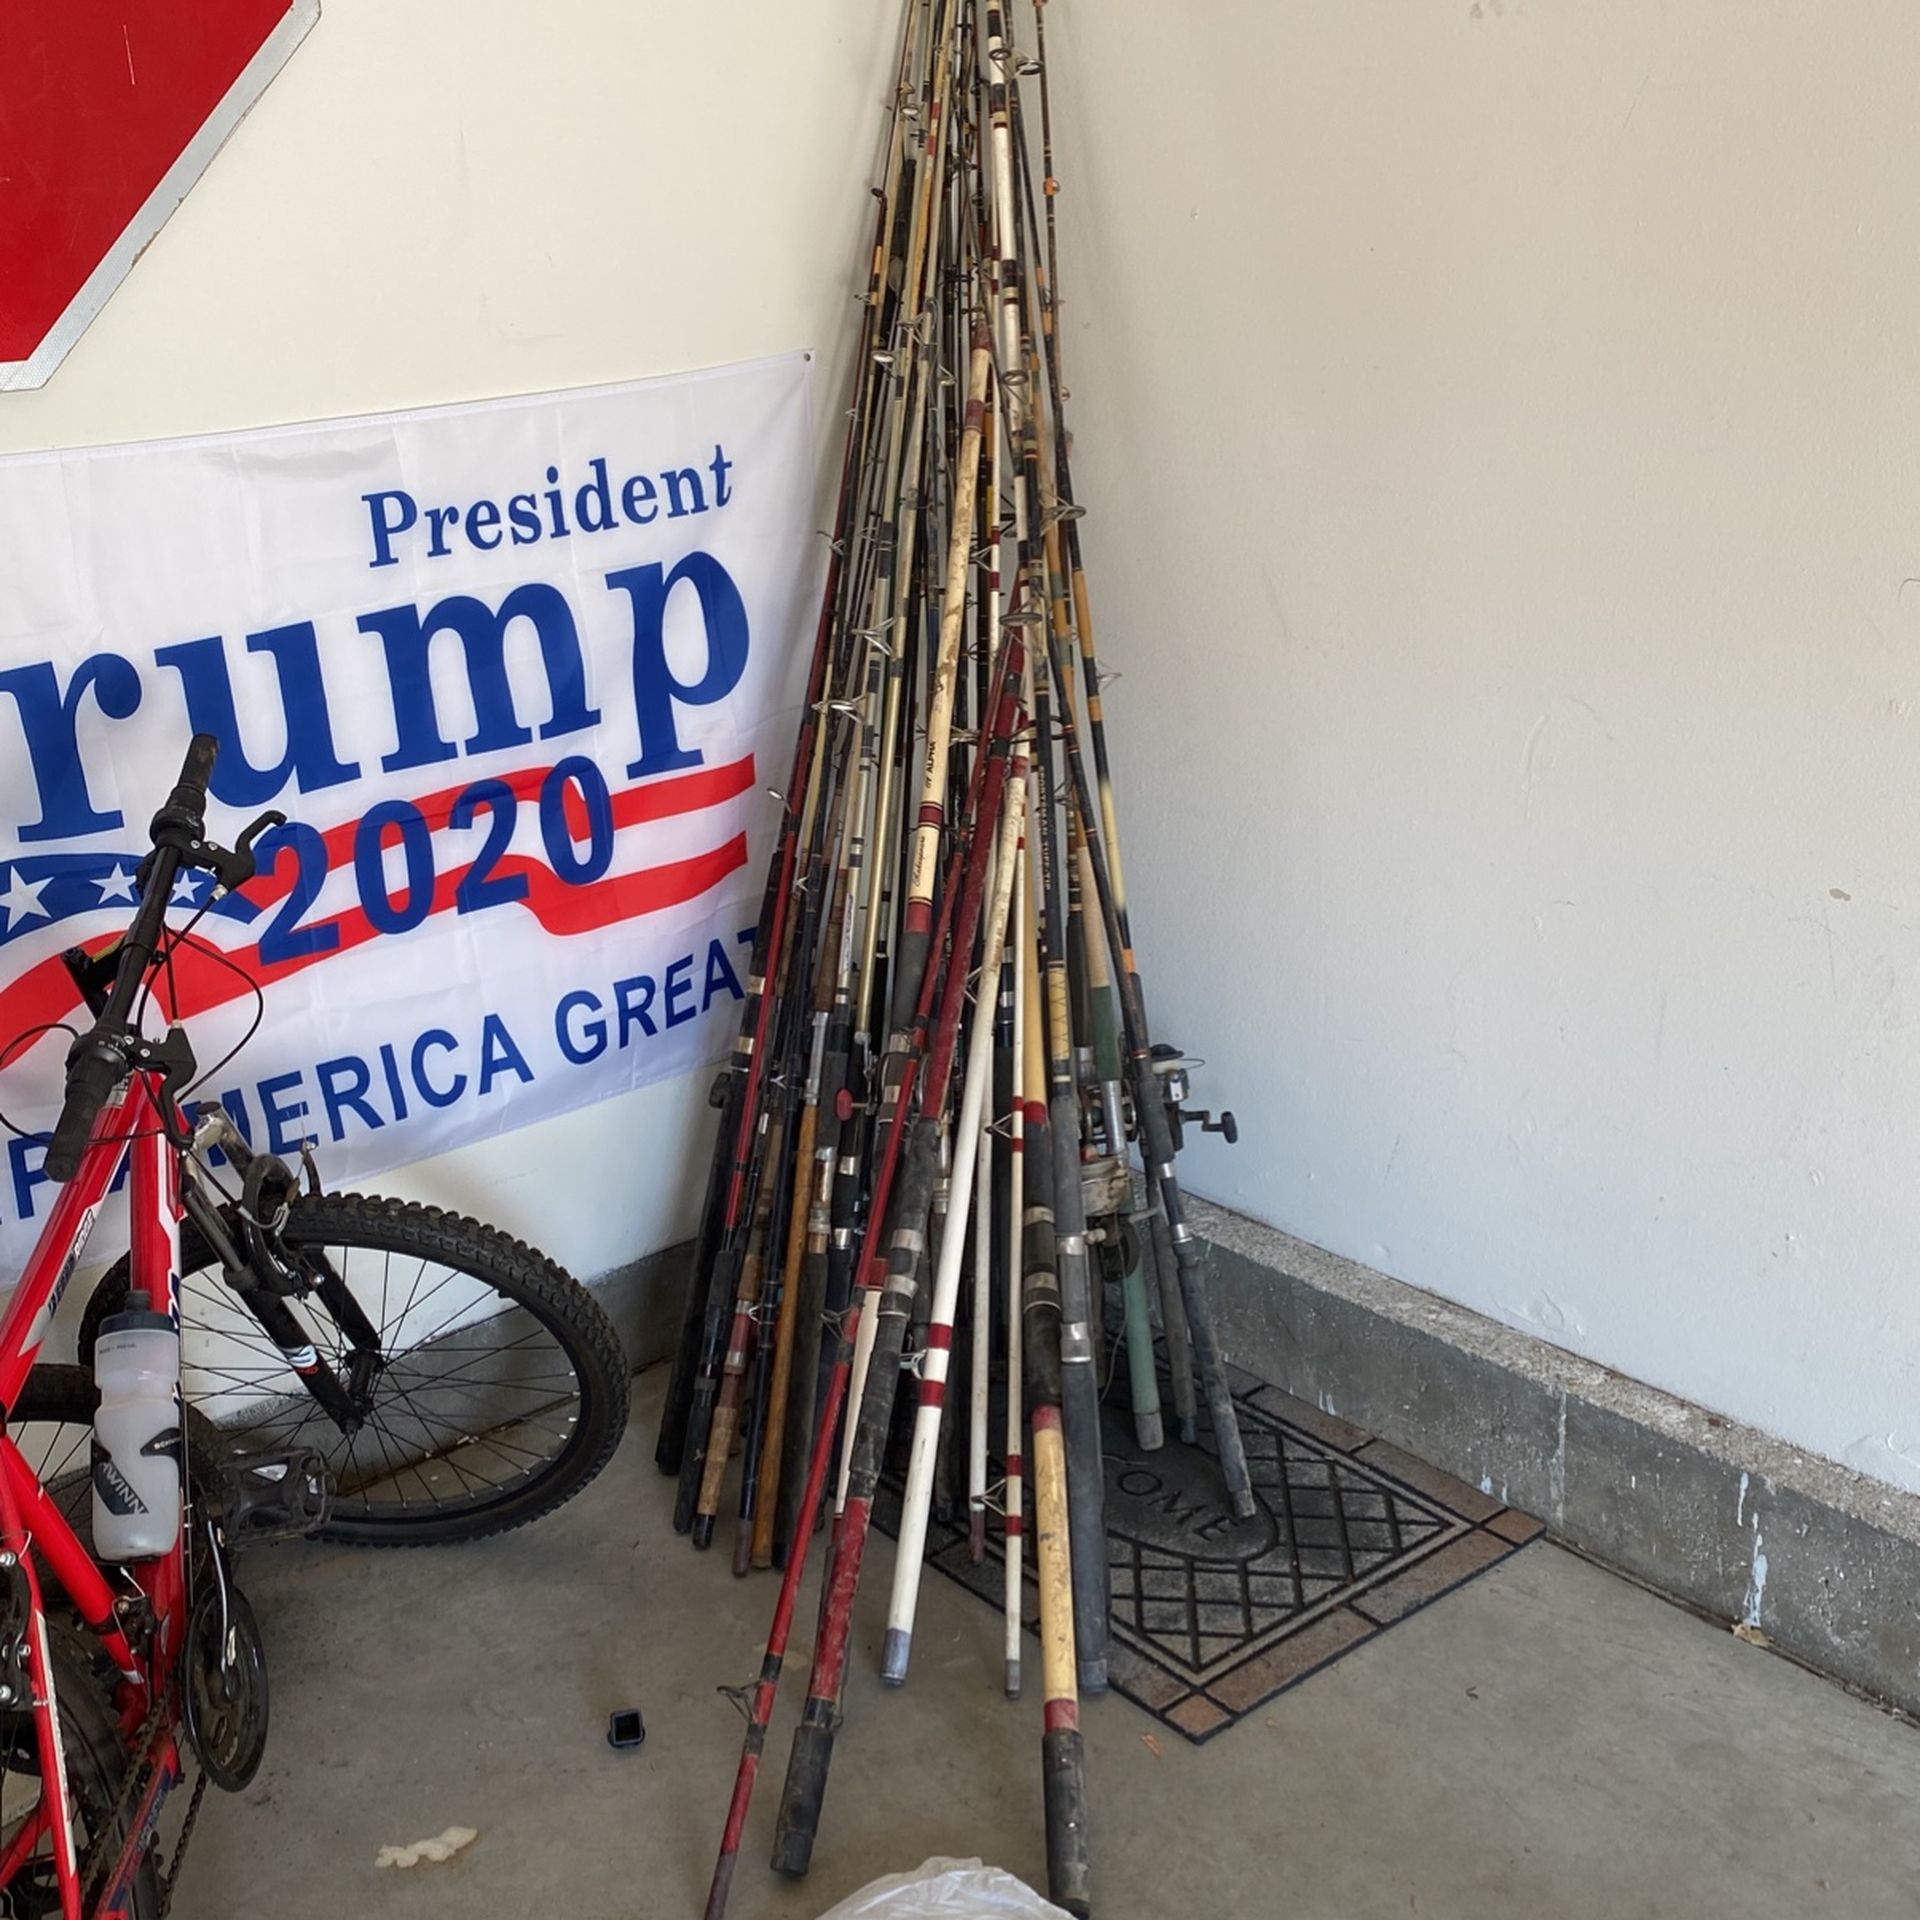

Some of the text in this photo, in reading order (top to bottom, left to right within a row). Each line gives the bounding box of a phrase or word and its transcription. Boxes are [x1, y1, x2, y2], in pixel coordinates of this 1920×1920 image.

[361, 444, 733, 568] President
[258, 755, 615, 967] 2020
[108, 1014, 535, 1194] MERICA
